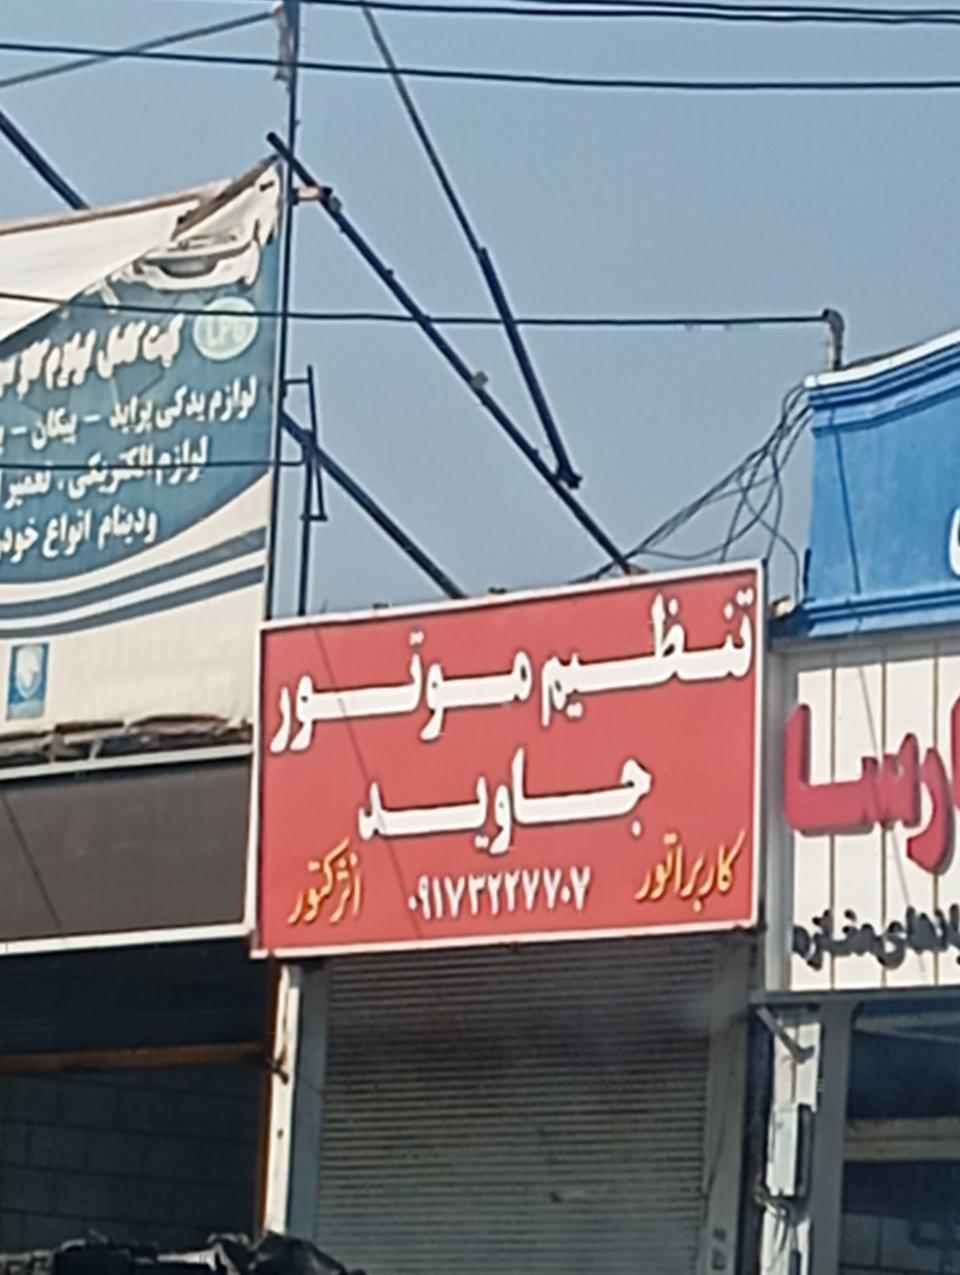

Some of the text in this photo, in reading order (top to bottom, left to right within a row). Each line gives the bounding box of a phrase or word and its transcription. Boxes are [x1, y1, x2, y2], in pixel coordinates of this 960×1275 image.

[109, 395, 153, 434] پراید
[156, 386, 206, 429] یدکی
[209, 375, 257, 423] لوازم
[30, 408, 77, 449] پیکان
[155, 435, 208, 486] لوازم
[42, 508, 93, 559] انواع
[270, 587, 756, 752] تنظیم موتور
[358, 747, 653, 854] جاوید
[287, 827, 746, 925] کاربراتور ۰۹۱۷۳۲۲۷۷۰۷ انژکتور
